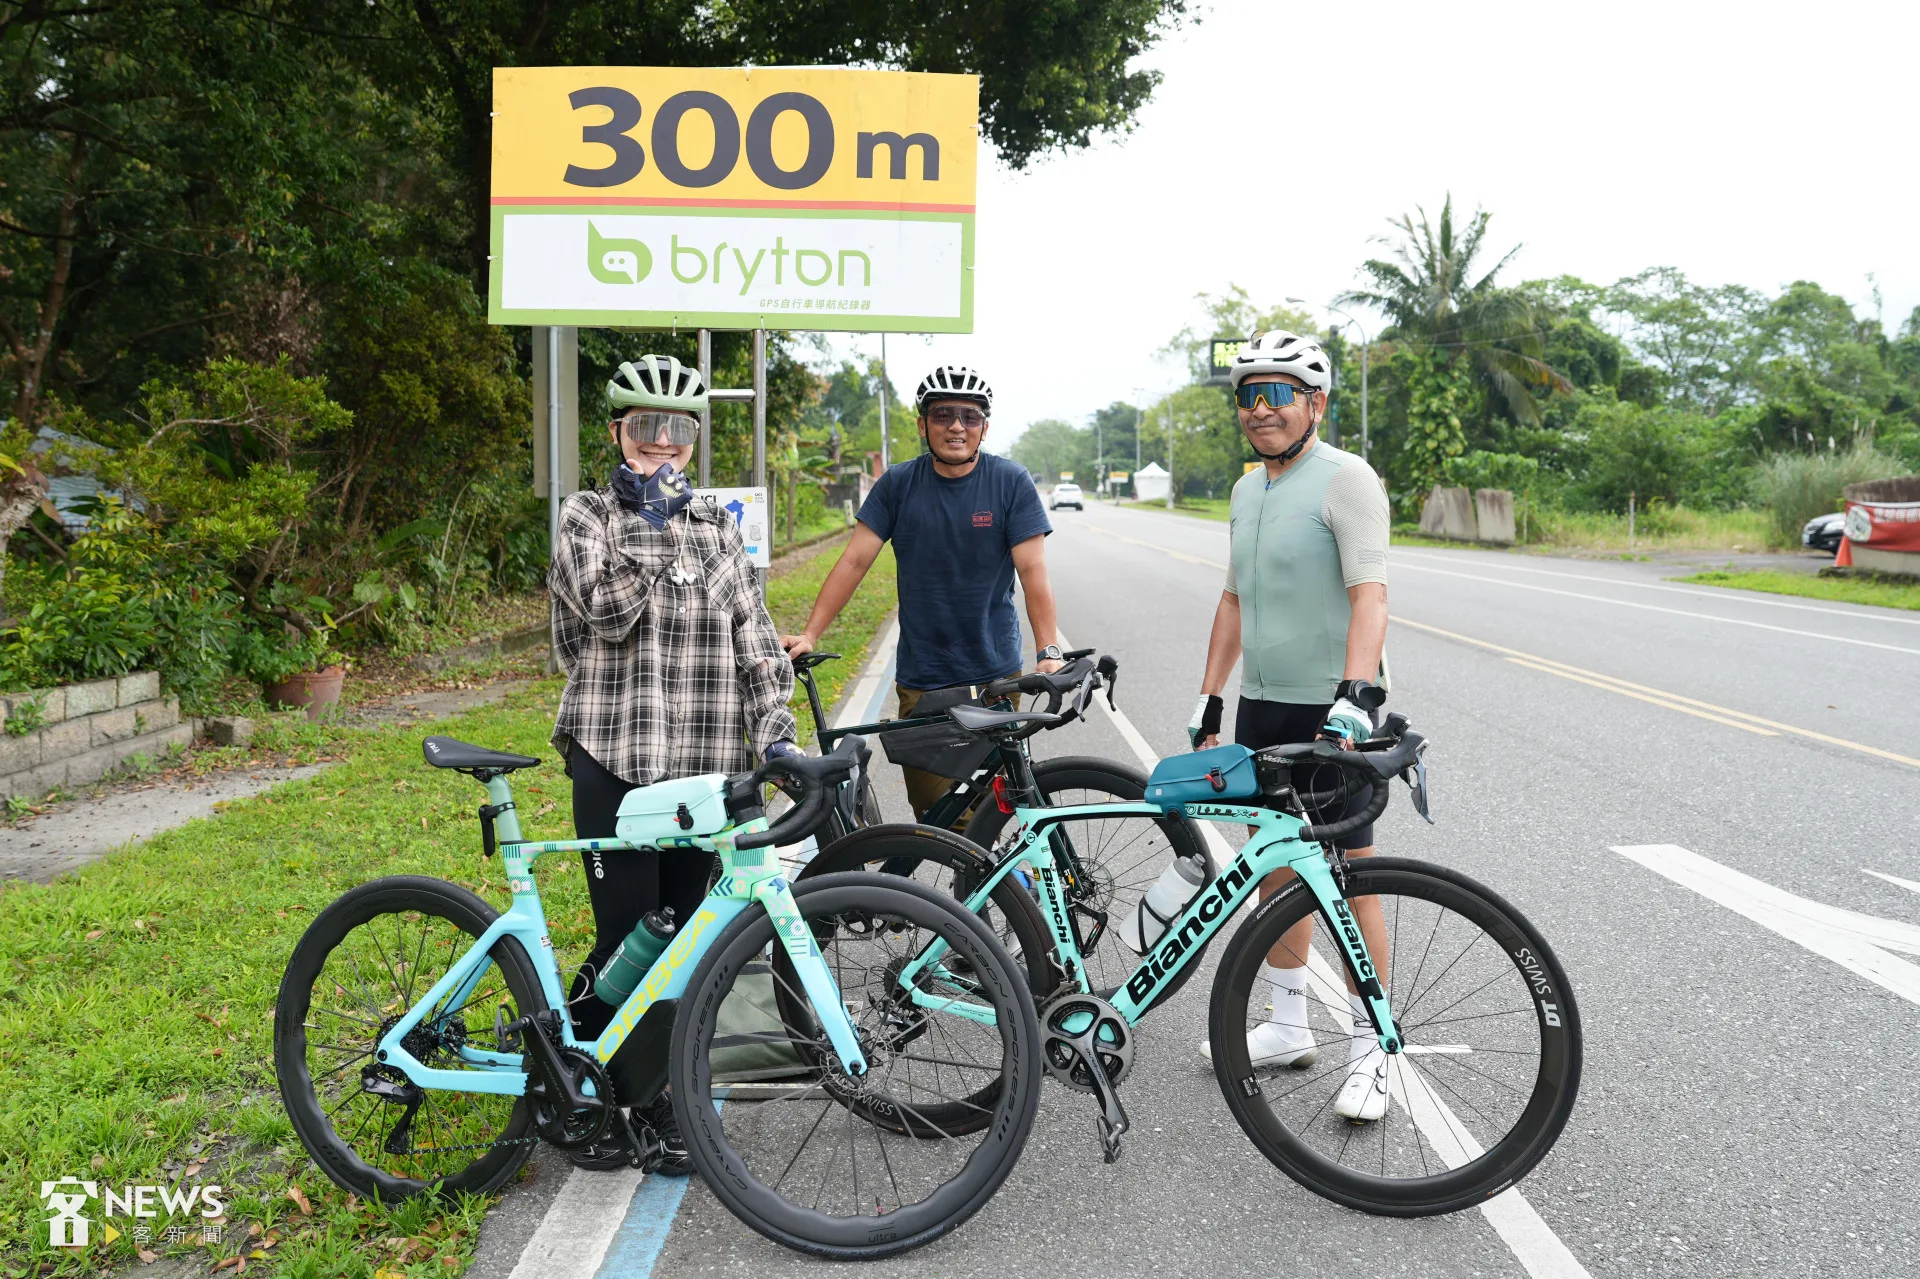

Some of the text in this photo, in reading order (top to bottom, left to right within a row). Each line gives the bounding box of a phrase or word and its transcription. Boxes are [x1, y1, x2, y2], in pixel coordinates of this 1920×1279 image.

[563, 86, 940, 190] 300 m
[671, 234, 871, 296] bryton
[1041, 867, 1071, 944] Bianchi
[1126, 853, 1254, 1006] Bianchi
[1256, 882, 1303, 920] CONTINENTA
[597, 909, 718, 1063] ORBEA
[944, 922, 1008, 998] CARBON
[1006, 1007, 1019, 1113] SPOKES
[1514, 947, 1562, 1028] DT SWISS
[691, 991, 715, 1096] SPOKES
